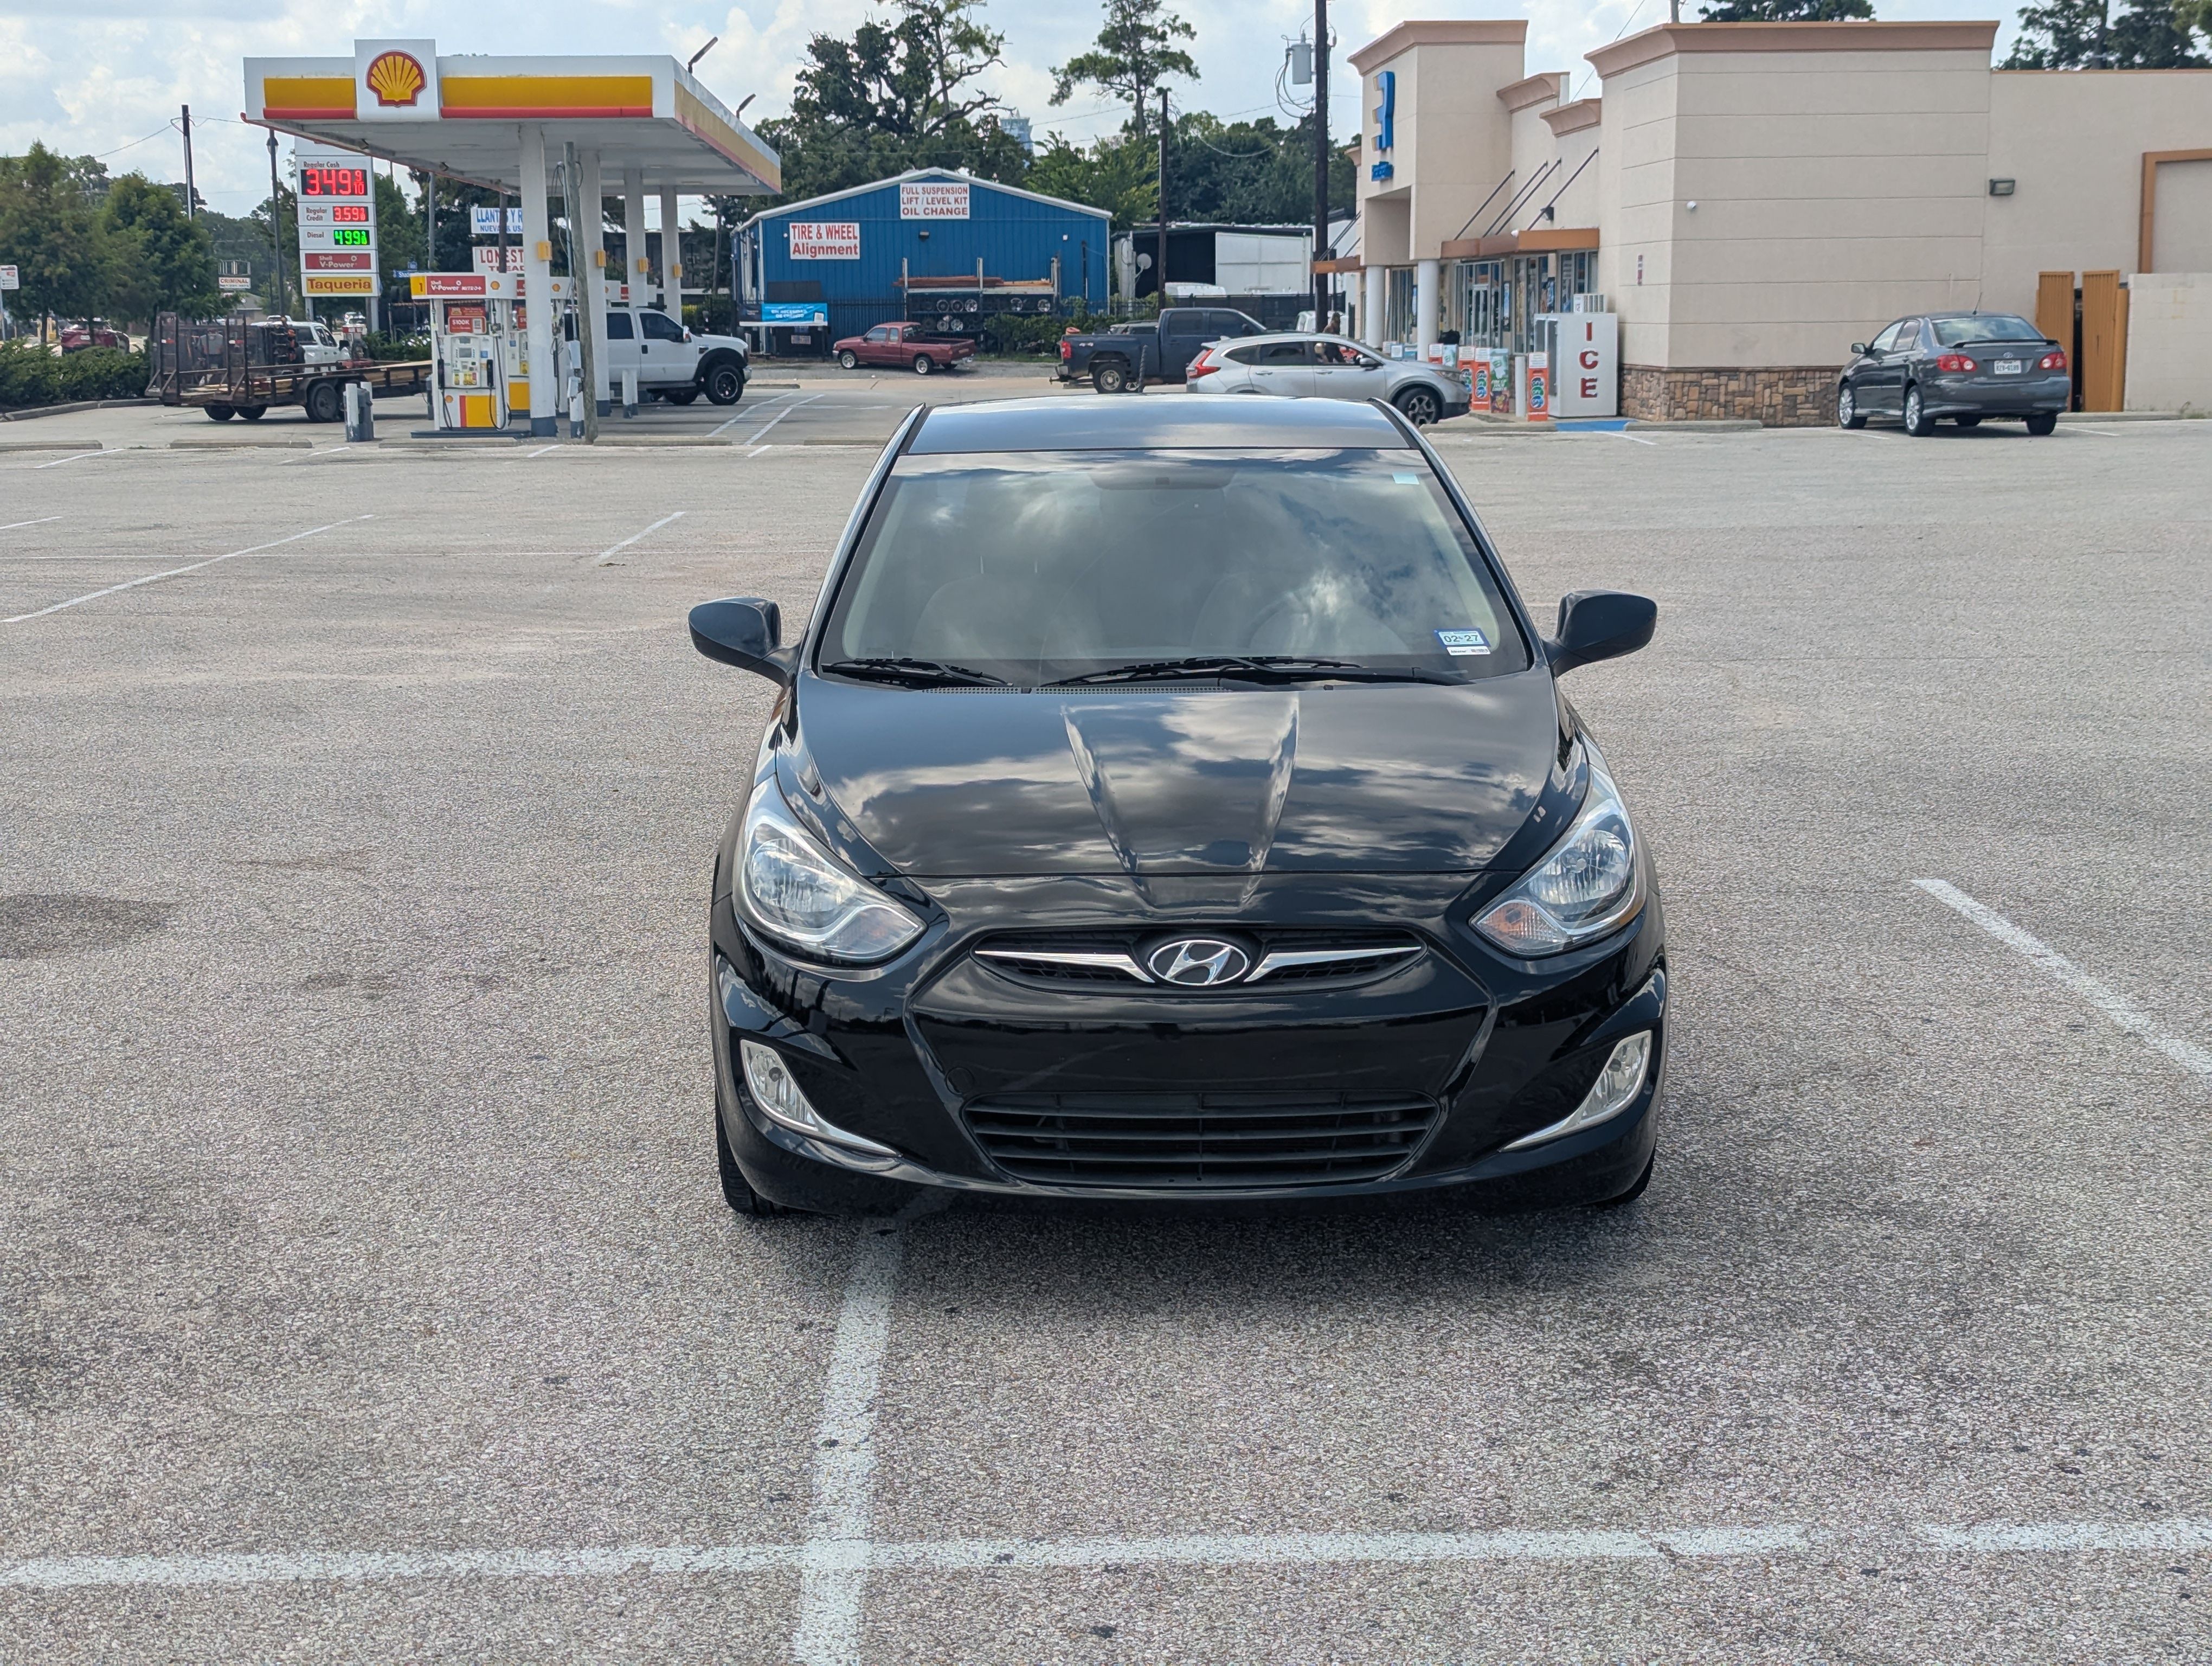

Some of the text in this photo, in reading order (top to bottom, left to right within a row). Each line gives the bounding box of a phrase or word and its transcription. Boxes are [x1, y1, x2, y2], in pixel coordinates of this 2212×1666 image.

[304, 161, 325, 169] Regular
[306, 169, 351, 195] 3.49
[902, 187, 968, 195] FULL SUSPENSION
[902, 197, 919, 205] LIFT
[926, 197, 951, 205] LEVEL
[954, 197, 968, 205] KIT
[511, 210, 516, 223] Y
[902, 208, 968, 216] OIL CHANGE
[792, 225, 858, 240] TIRE & WHEEL
[793, 242, 858, 258] Alignment
[307, 279, 371, 292] Taqueria
[419, 283, 423, 292] 1
[1579, 320, 1599, 398] ICE
